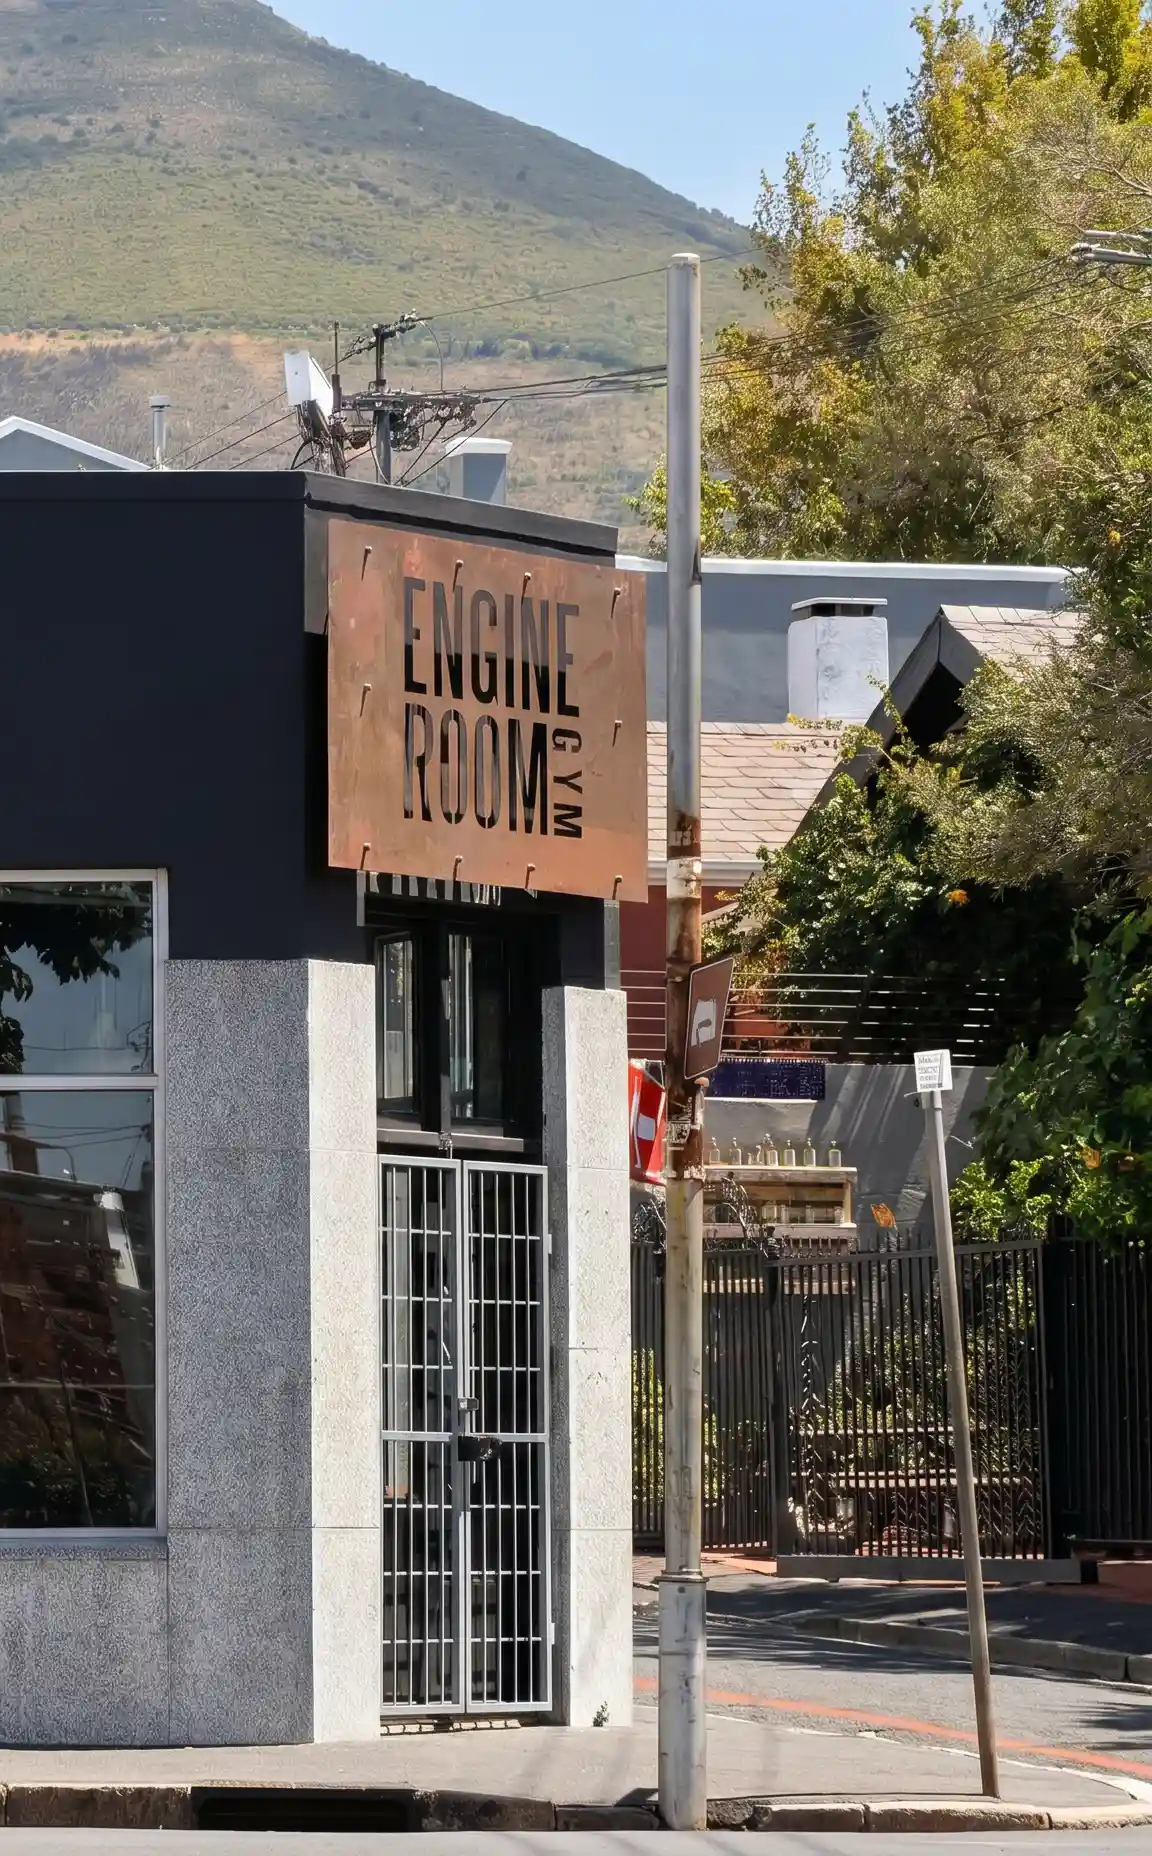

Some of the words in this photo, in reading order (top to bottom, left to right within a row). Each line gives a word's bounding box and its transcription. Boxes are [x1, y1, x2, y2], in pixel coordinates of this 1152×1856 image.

[403, 576, 580, 718] ENGINE
[403, 702, 548, 836] ROOM
[552, 728, 583, 839] GYM
